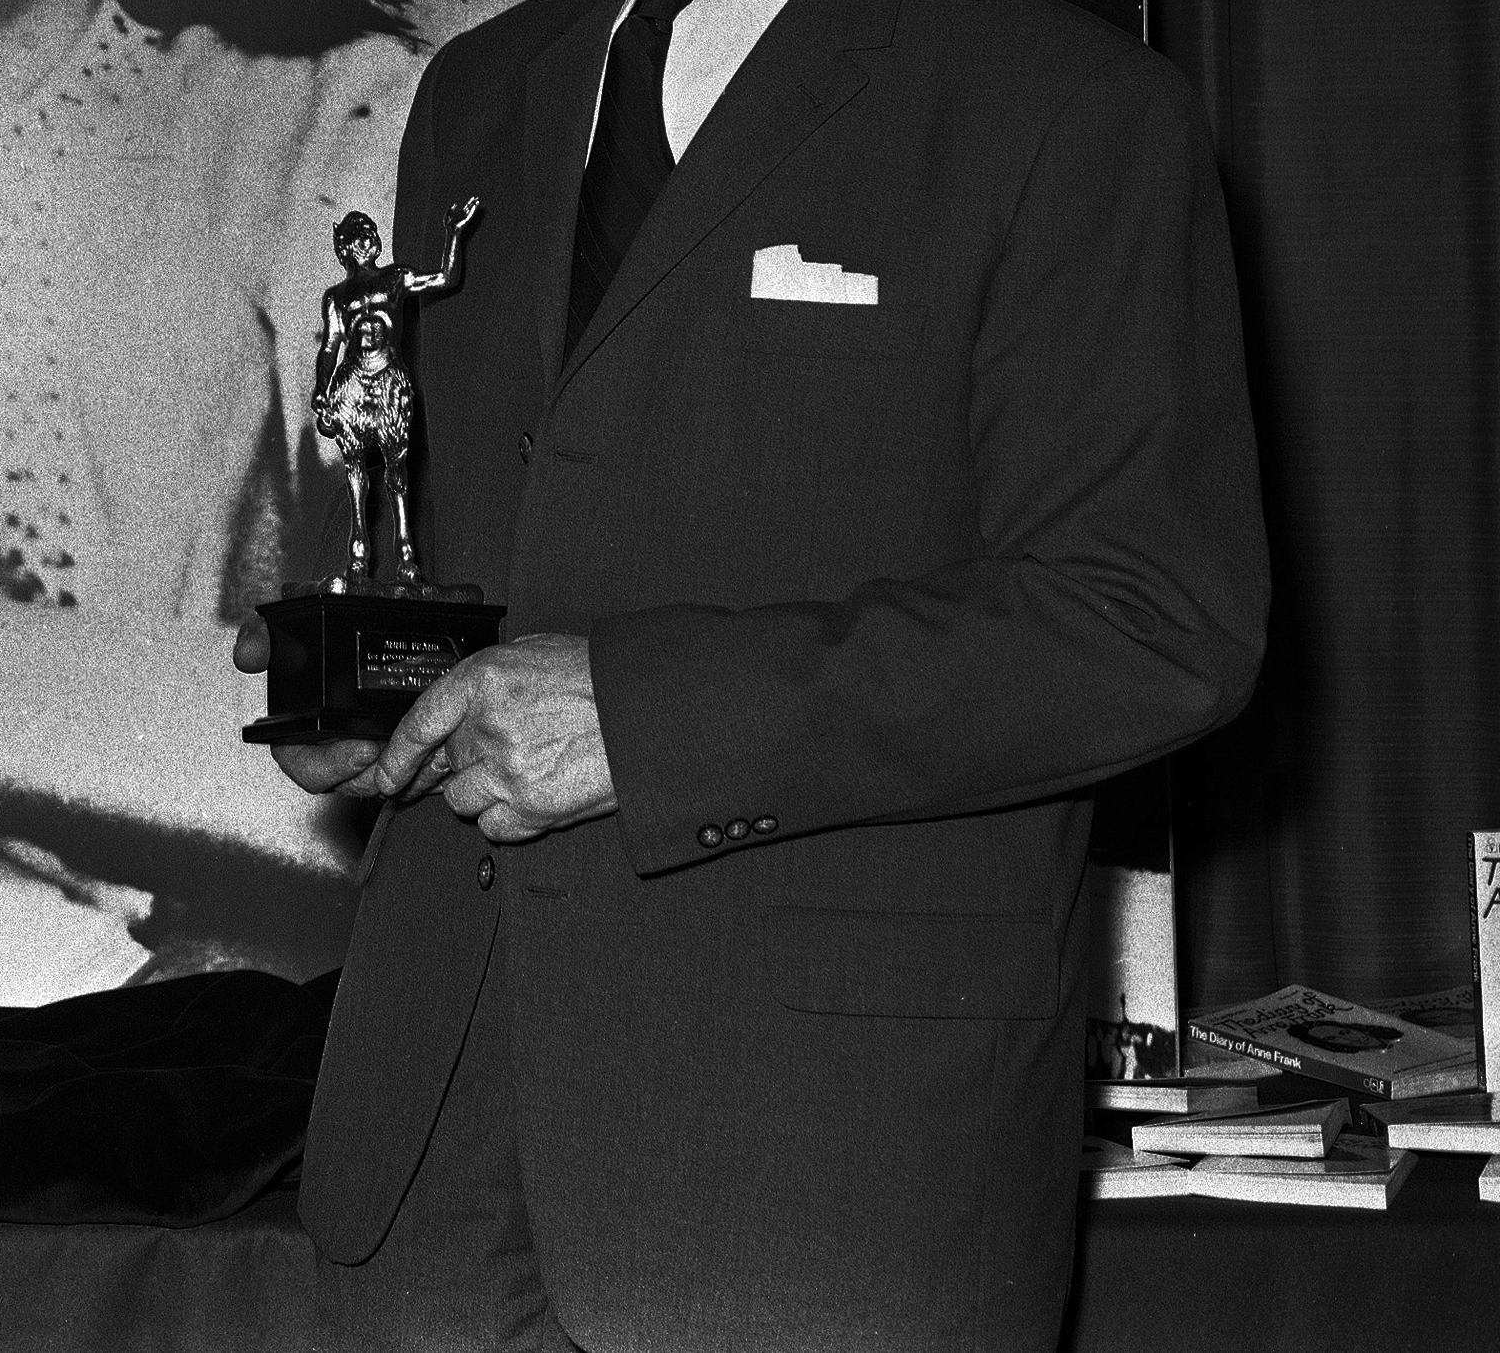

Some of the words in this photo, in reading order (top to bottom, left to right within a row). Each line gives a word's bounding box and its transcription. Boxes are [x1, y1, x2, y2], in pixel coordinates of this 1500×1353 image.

[1212, 1017, 1257, 1031] The
[1255, 1003, 1308, 1024] diary
[1190, 1025, 1208, 1041] The
[1209, 1032, 1234, 1051] Diary
[1235, 1041, 1246, 1053] of
[1247, 1044, 1272, 1060] Anne
[1273, 1051, 1302, 1070] Frank
